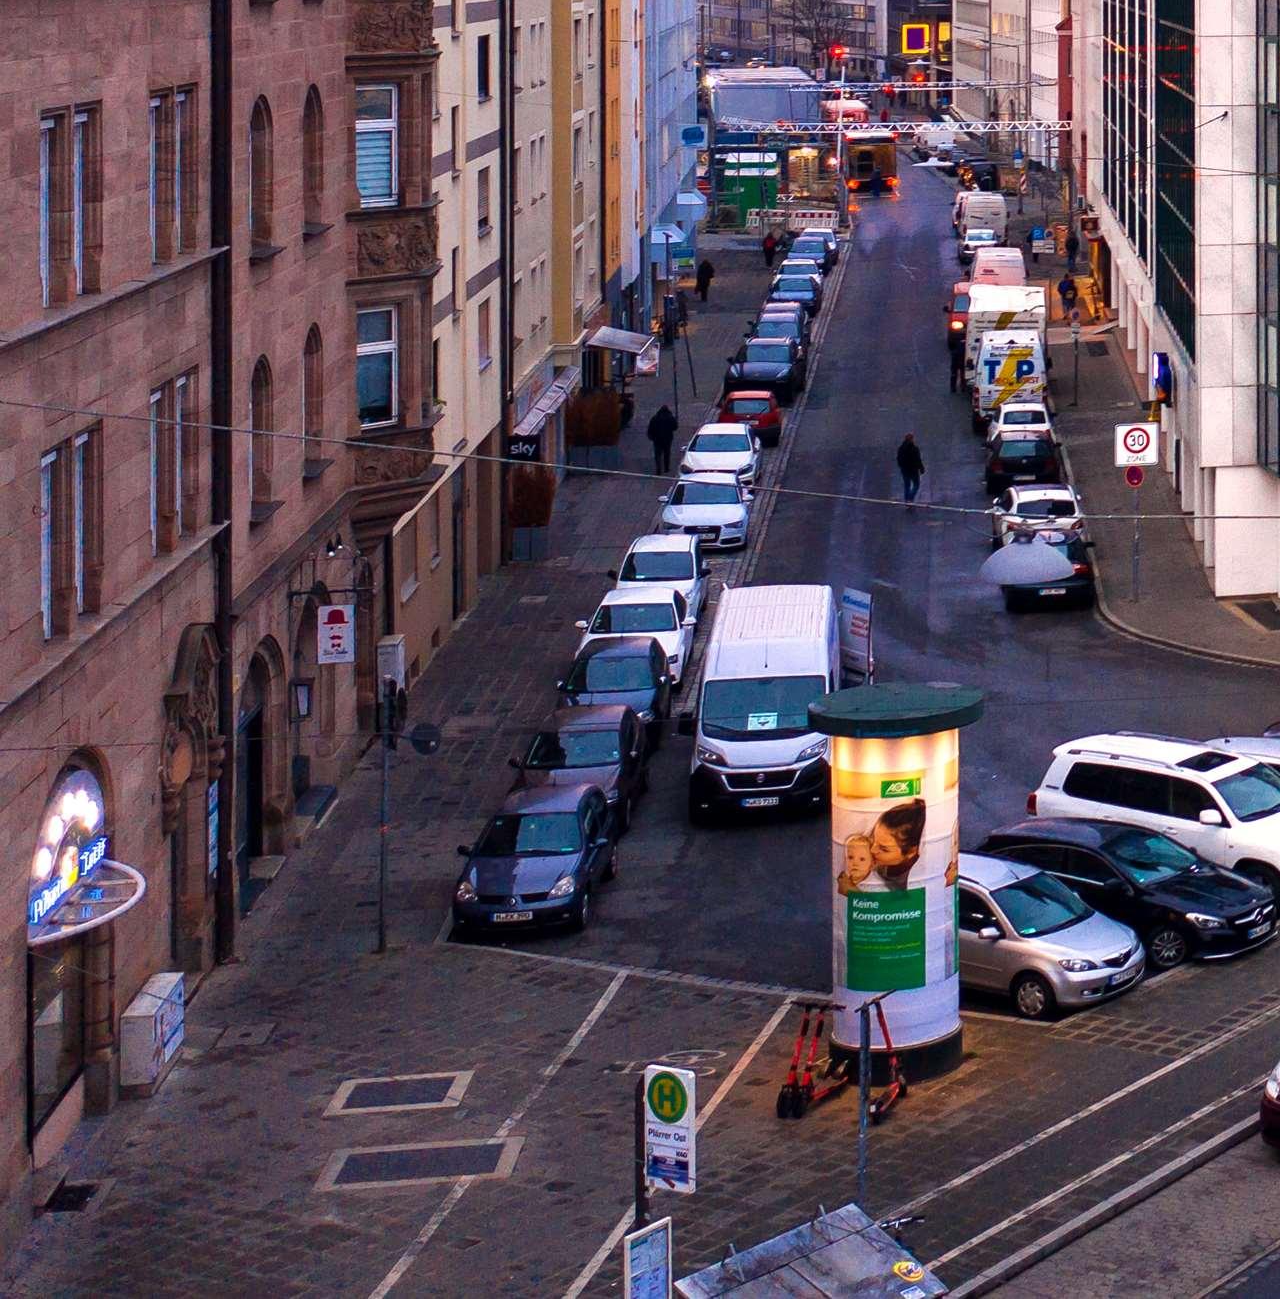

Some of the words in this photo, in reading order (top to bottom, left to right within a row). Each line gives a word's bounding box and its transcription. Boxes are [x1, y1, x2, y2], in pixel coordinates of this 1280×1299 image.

[1129, 434, 1145, 447] 30
[511, 442, 537, 456] sky
[885, 782, 910, 794] AOK
[852, 899, 880, 909] Keine
[852, 909, 922, 923] Kompromisse
[658, 1084, 676, 1109] H
